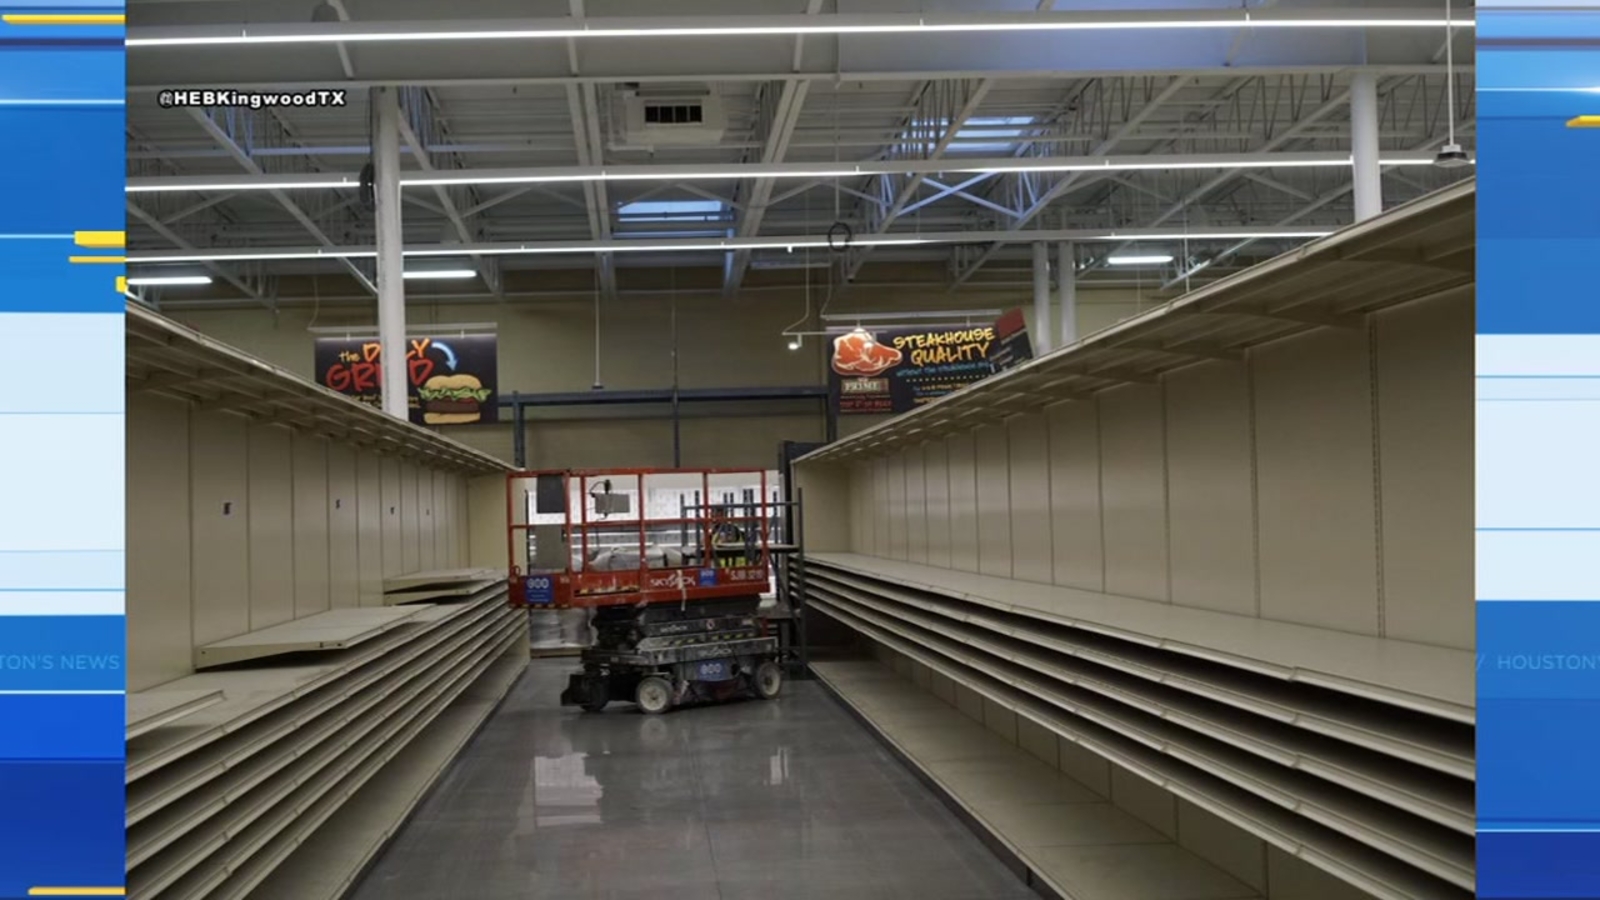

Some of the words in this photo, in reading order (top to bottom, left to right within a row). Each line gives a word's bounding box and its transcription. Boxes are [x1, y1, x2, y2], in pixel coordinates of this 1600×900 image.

[893, 327, 995, 349] STEAKHOUSE
[339, 351, 360, 363] the
[910, 342, 990, 367] QUALITY
[326, 358, 434, 391] GRID
